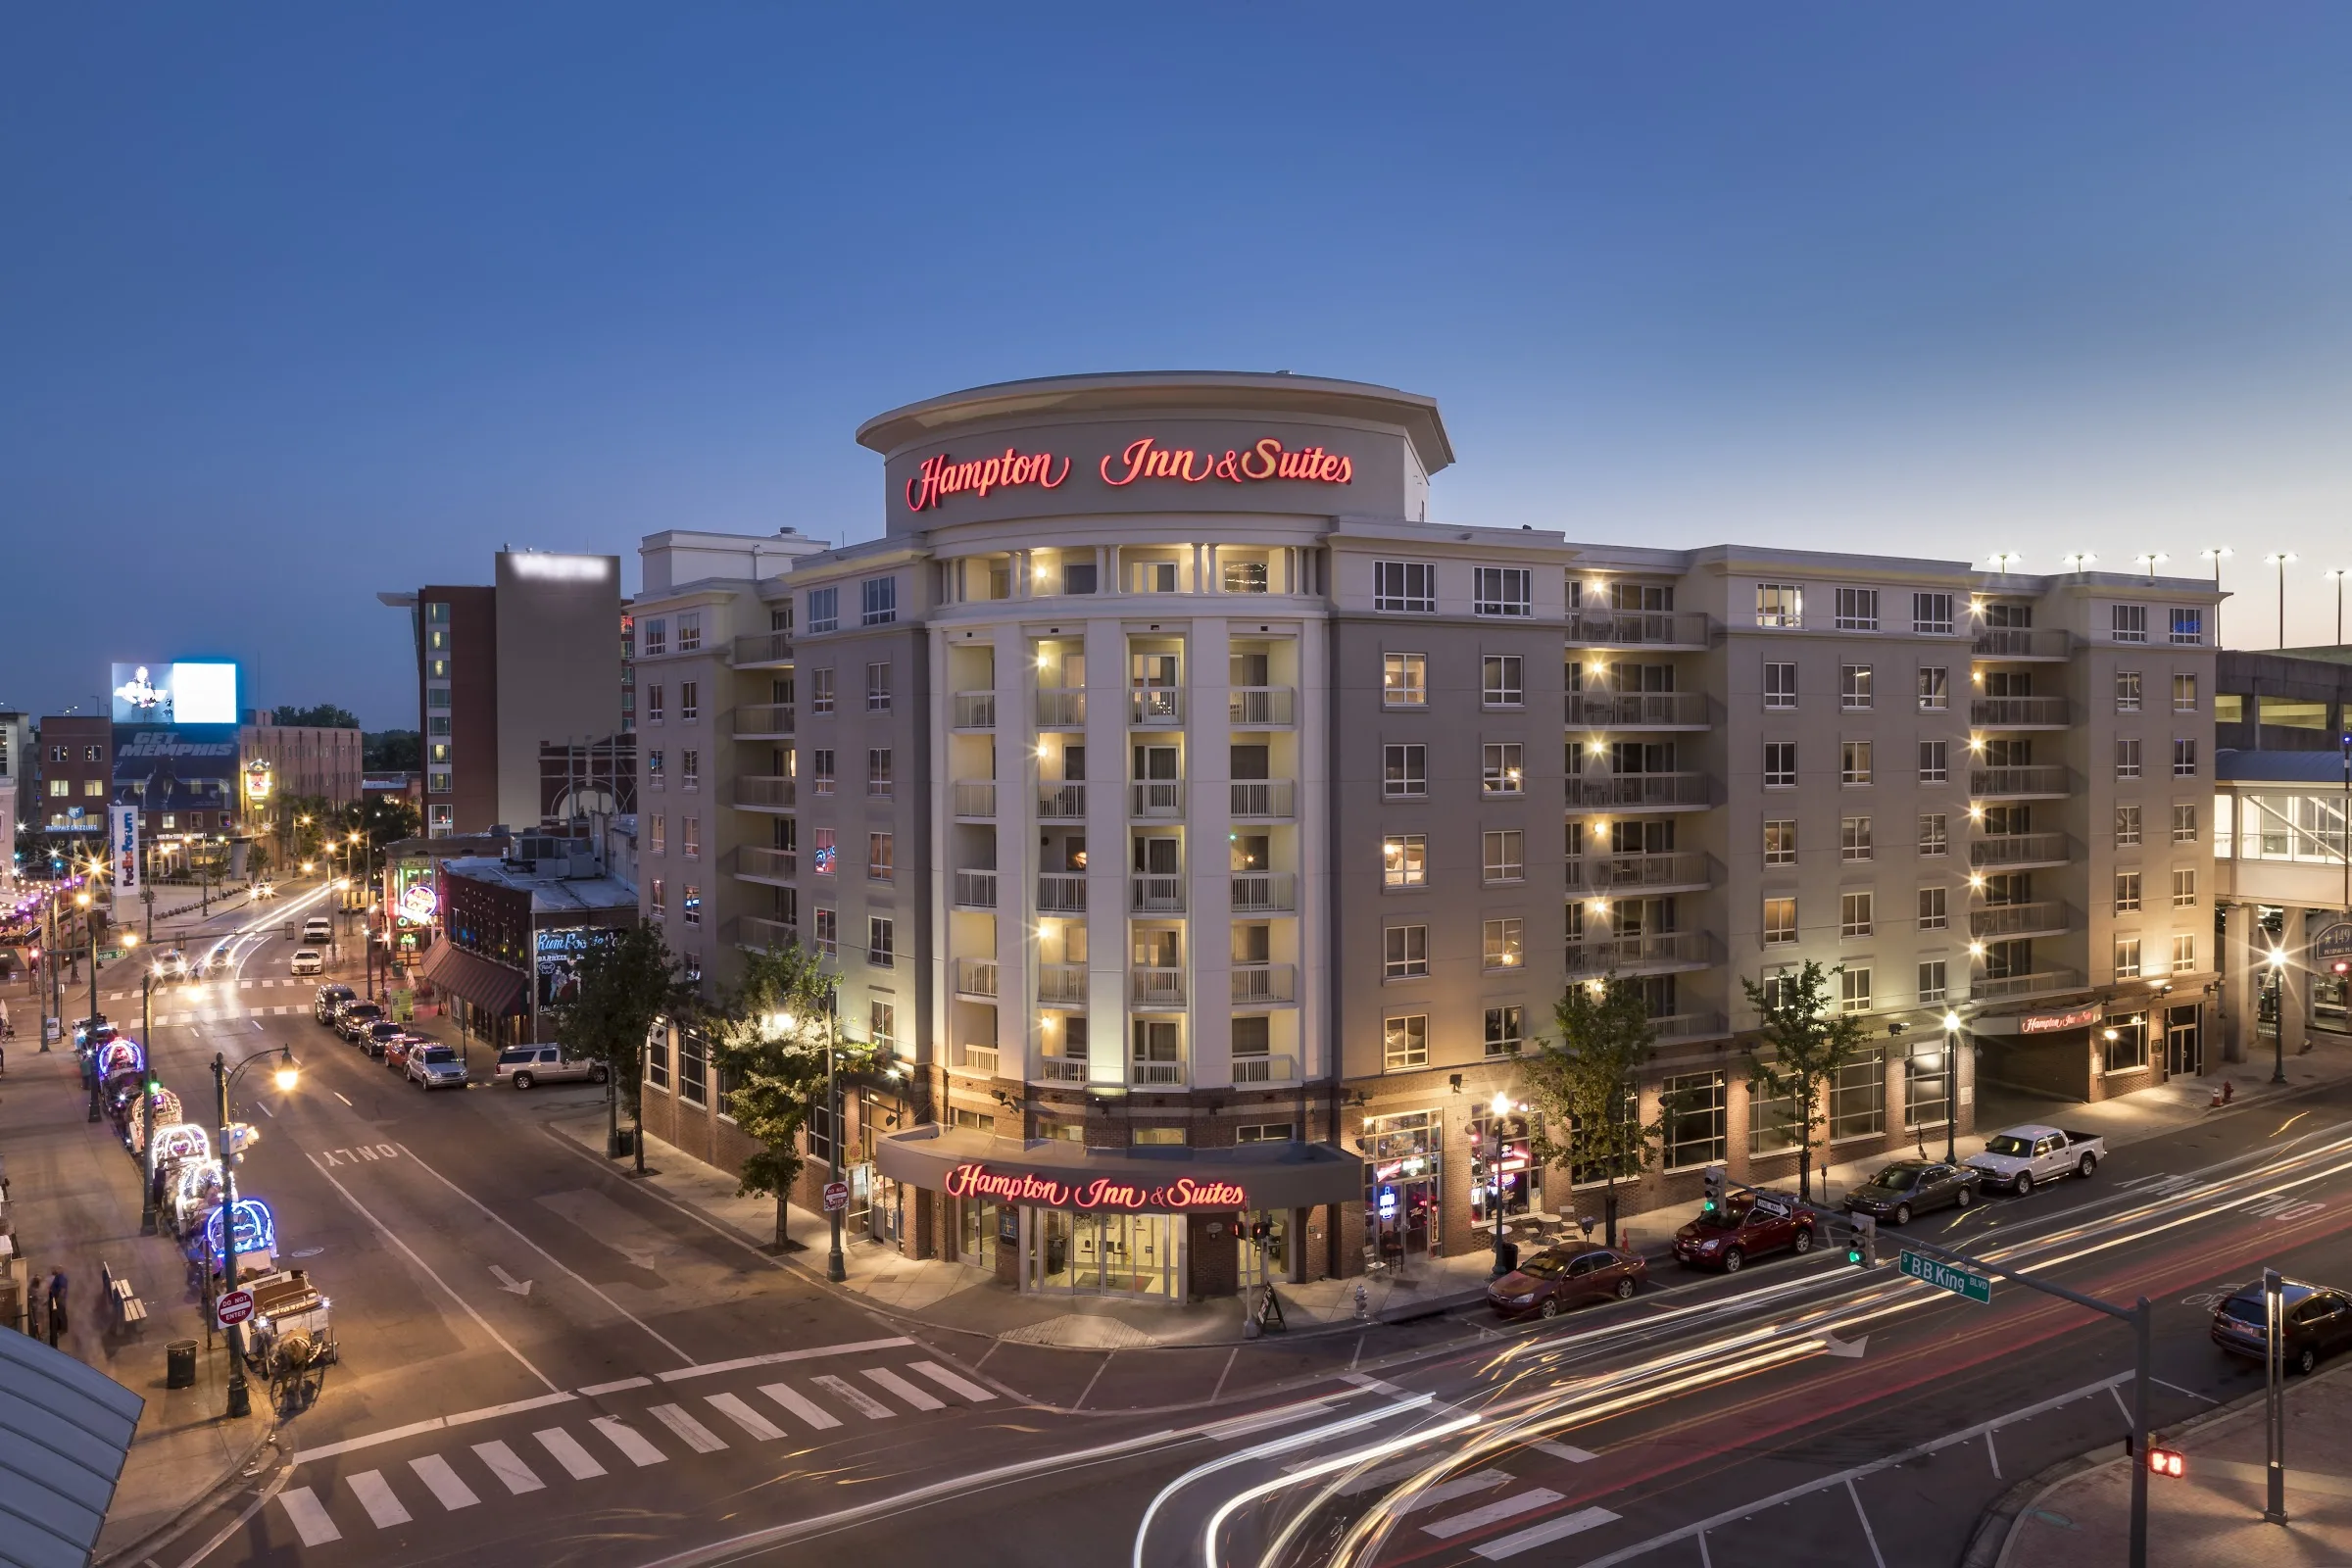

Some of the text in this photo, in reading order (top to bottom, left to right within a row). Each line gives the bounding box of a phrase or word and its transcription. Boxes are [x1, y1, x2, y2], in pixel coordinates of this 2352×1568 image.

[906, 438, 1352, 512] Hampton Inn & Suites
[133, 732, 178, 744] GET
[119, 744, 234, 757] MEMPHIS
[537, 934, 564, 950] Rum
[2022, 1017, 2063, 1032] Hampton
[322, 1144, 399, 1166] ONLY
[946, 1163, 1244, 1207] Hampton Inn & Suites
[1903, 1254, 1908, 1263] S
[1936, 1265, 1964, 1293] King
[1970, 1277, 1987, 1290] BLVD
[225, 1309, 246, 1321] ENTER
